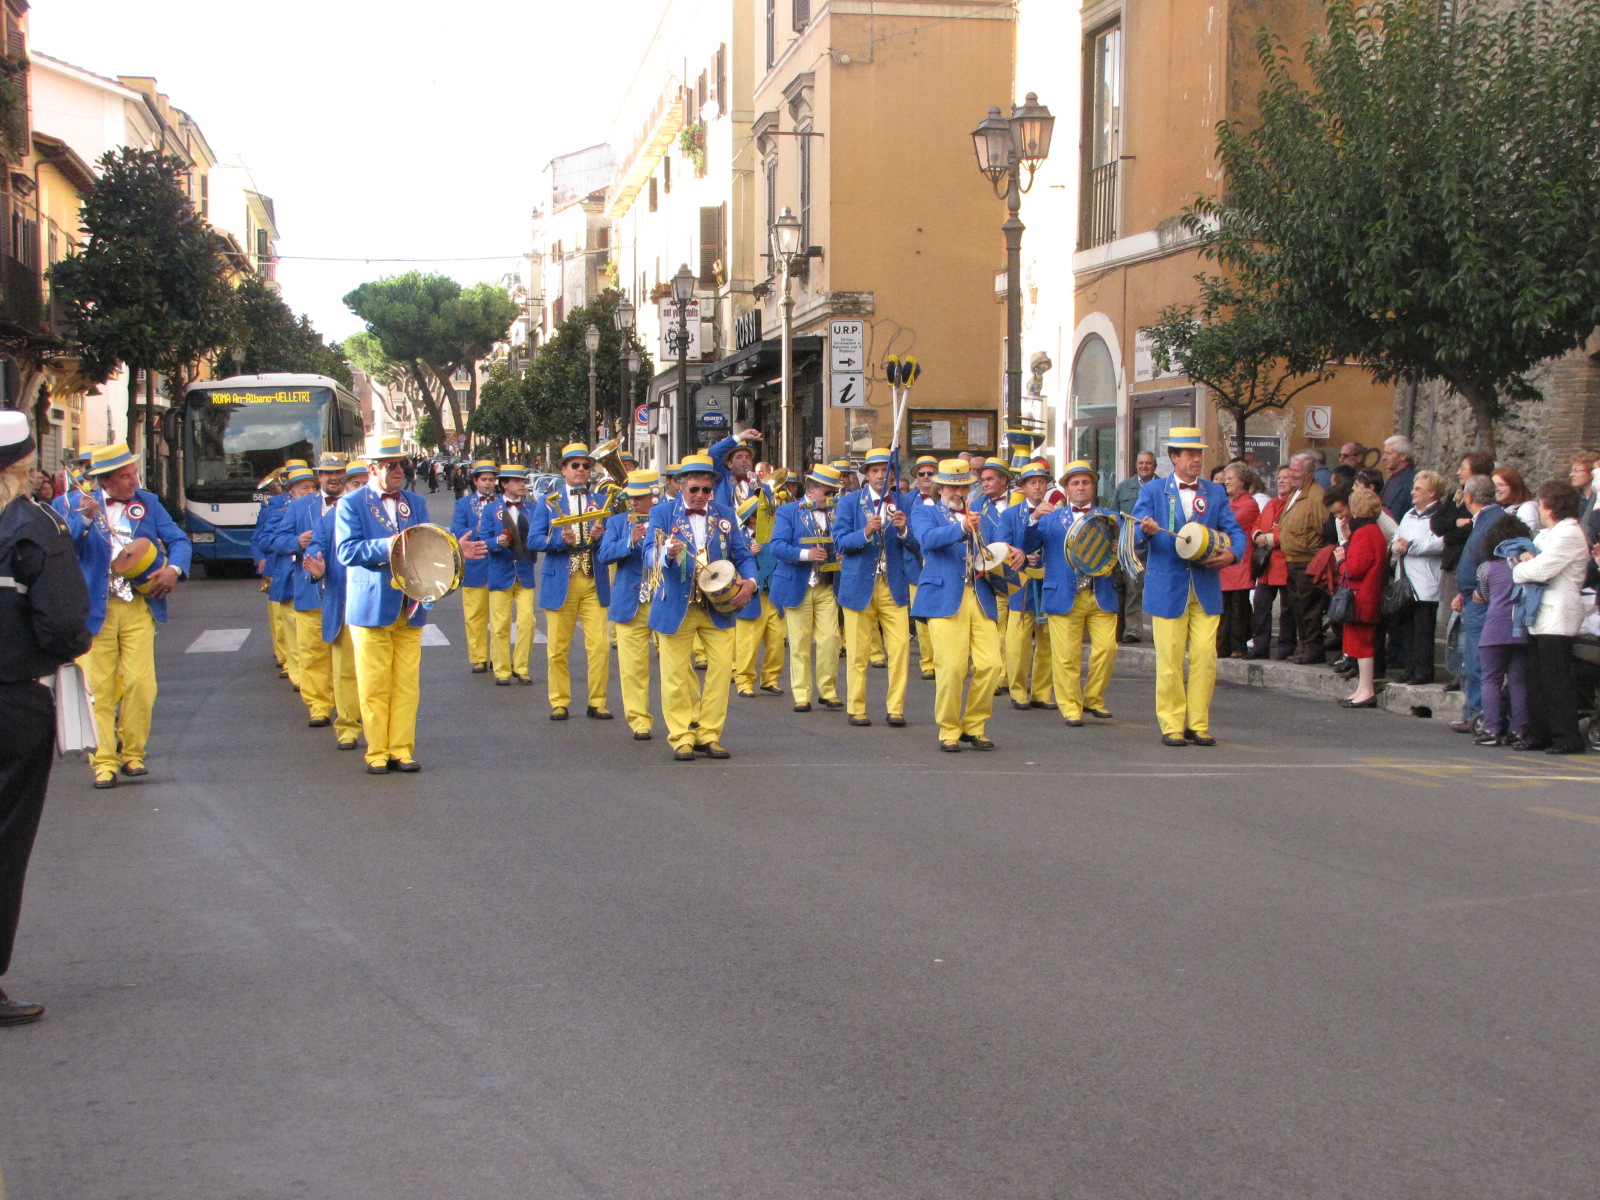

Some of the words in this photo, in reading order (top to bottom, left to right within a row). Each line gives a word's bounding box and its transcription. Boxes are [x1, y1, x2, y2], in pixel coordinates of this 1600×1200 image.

[663, 308, 672, 317] not
[736, 309, 756, 349] ROSSI
[834, 326, 860, 335] U.R.P.
[839, 377, 856, 404] i
[212, 393, 231, 404] ROMA
